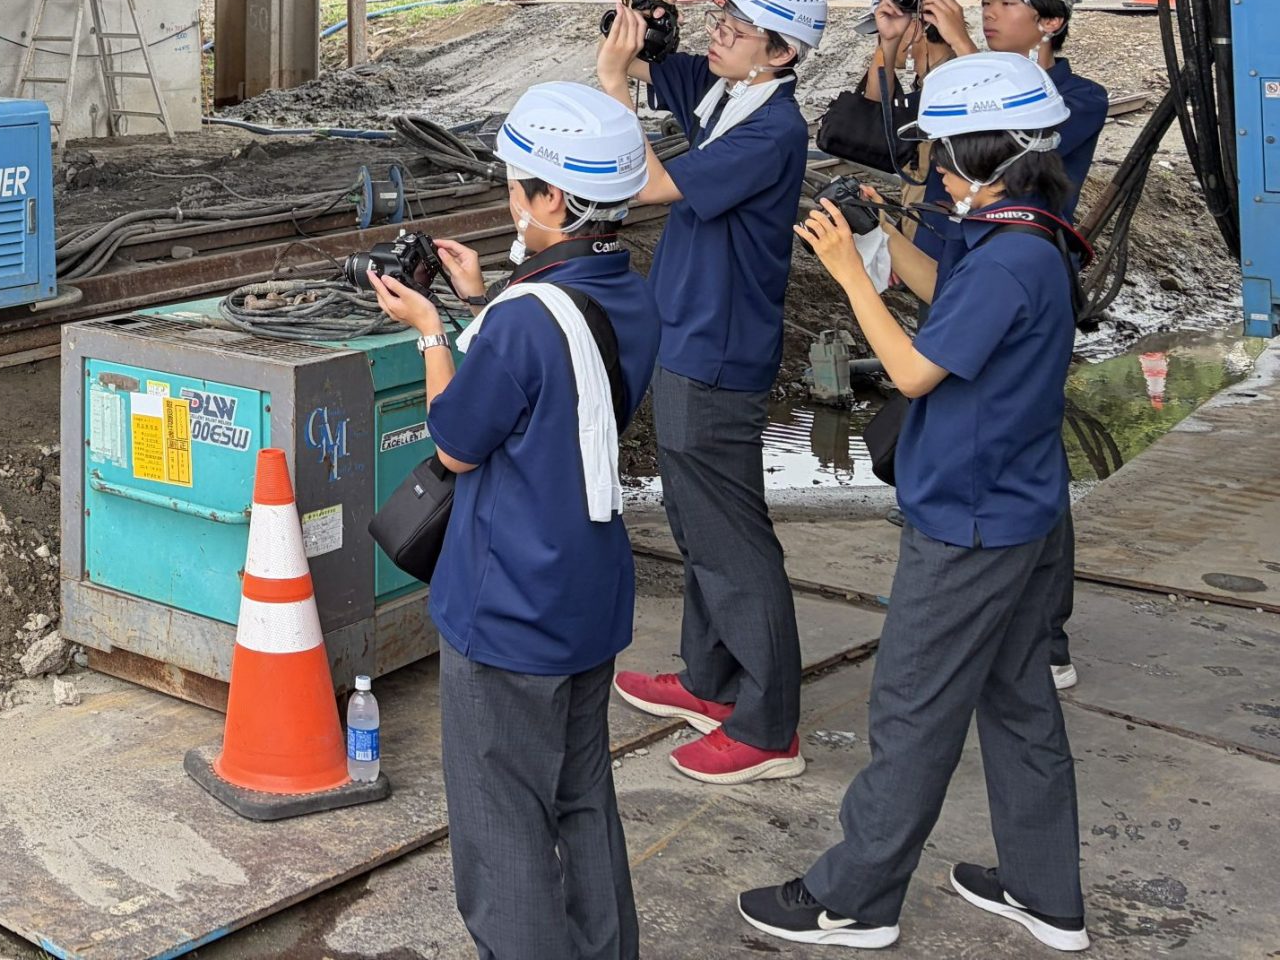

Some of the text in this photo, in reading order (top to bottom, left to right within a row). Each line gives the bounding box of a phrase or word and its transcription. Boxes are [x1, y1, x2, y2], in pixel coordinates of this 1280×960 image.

[249, 4, 268, 32] 50
[797, 14, 812, 25] AMA
[972, 99, 997, 111] AMA
[537, 146, 559, 163] AMA
[986, 211, 1035, 221] Canon
[181, 389, 236, 421] DLW
